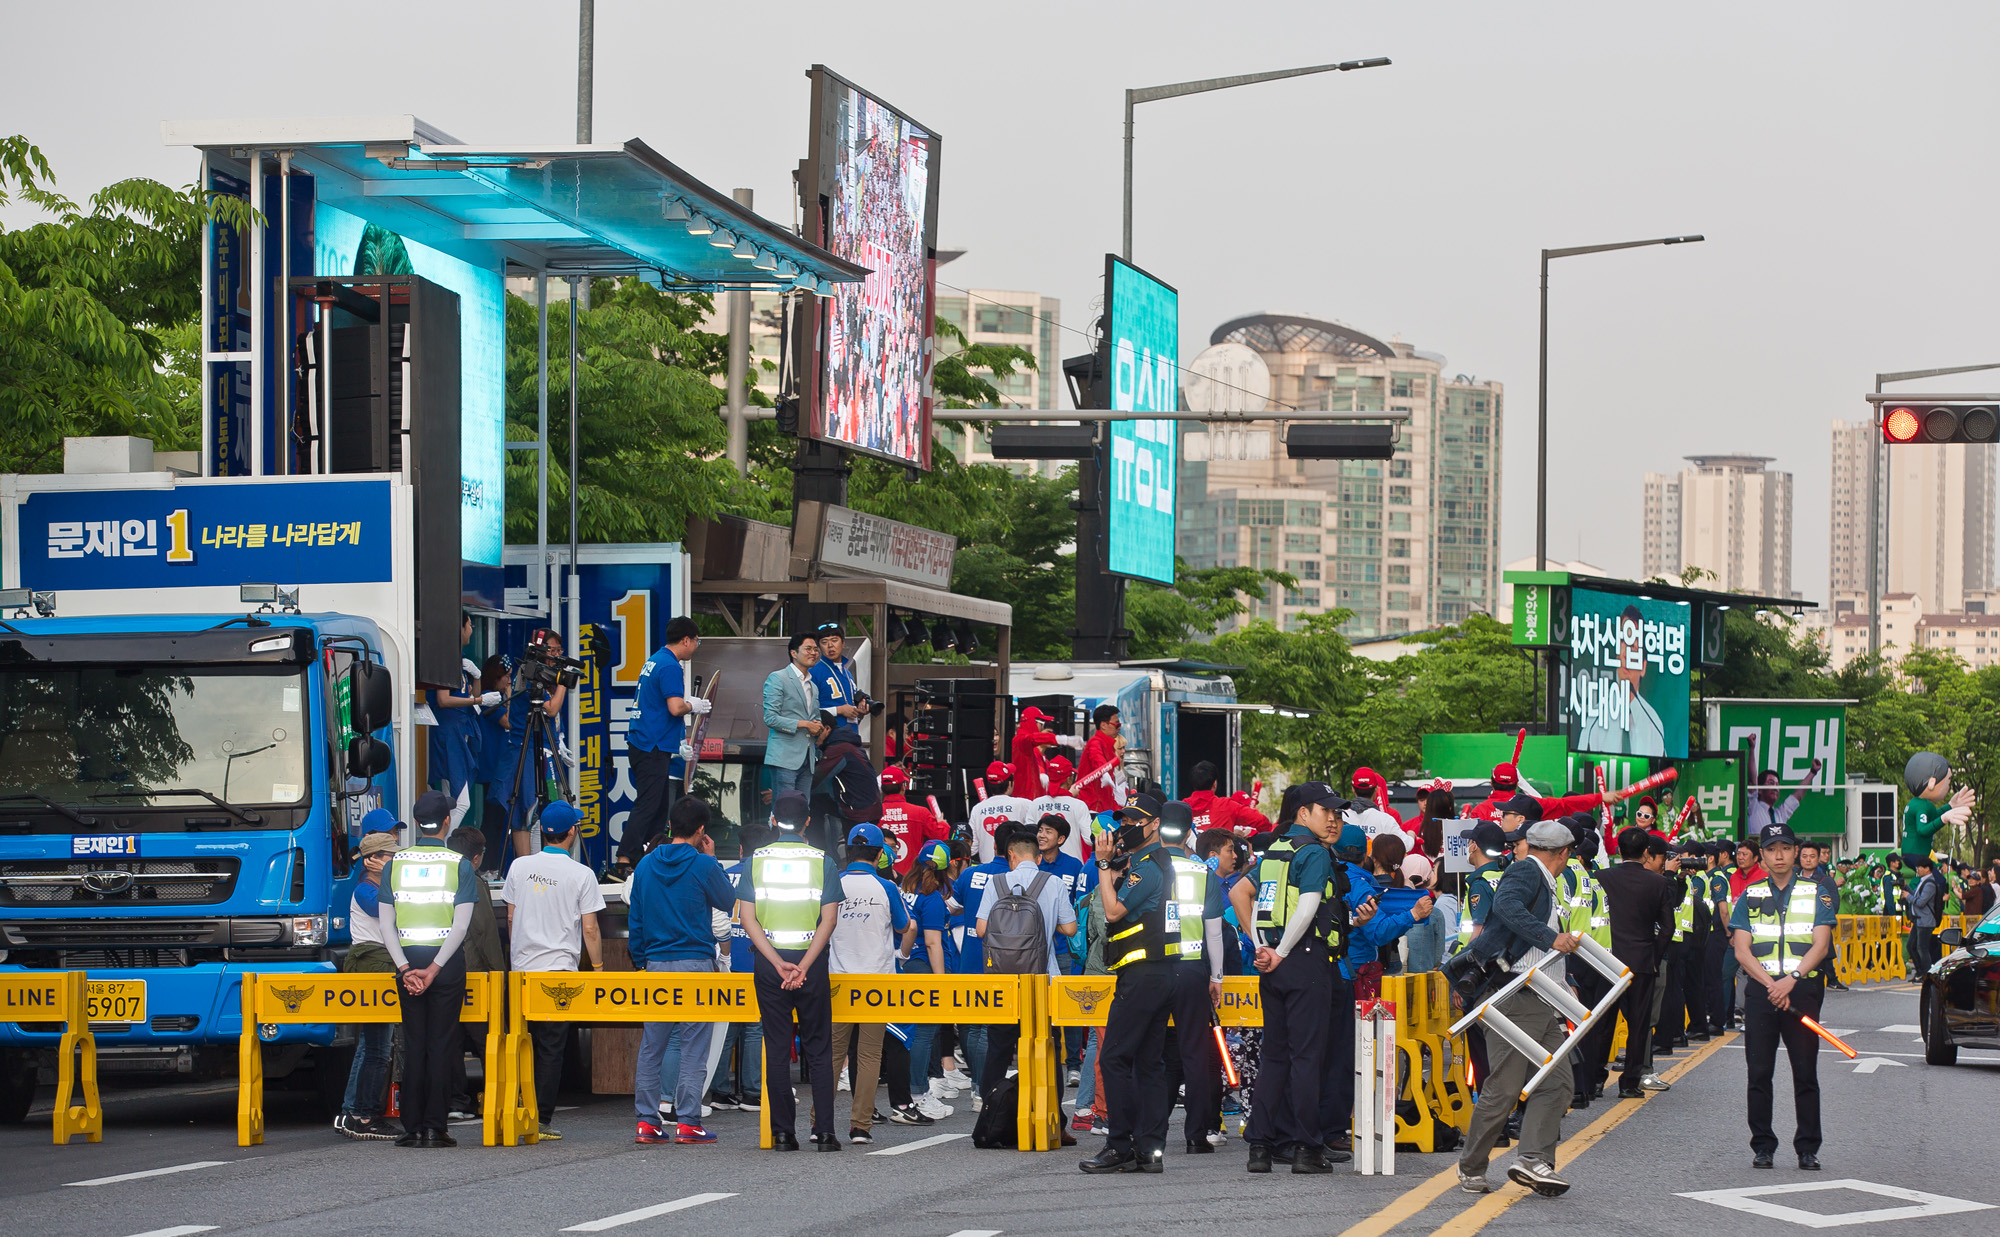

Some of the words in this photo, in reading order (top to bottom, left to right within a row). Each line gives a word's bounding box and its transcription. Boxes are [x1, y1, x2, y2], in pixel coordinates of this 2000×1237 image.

[1113, 337, 1175, 514] 유승민
[48, 520, 157, 558] 문재인
[166, 509, 194, 563] 1
[202, 524, 268, 549] 나라를
[272, 521, 361, 548] 나라답게
[1525, 602, 1538, 642] 안철수
[1554, 588, 1567, 642] 3
[611, 589, 651, 687] 1
[1707, 608, 1720, 659] 3
[826, 677, 842, 699] 1
[1570, 675, 1630, 732] 시대에
[1727, 718, 1840, 796] 미래
[579, 735, 602, 838] 대통령
[980, 805, 1013, 816] 사랑해요
[1038, 802, 1071, 812] 사랑해요
[1697, 785, 1734, 841] 변
[1920, 813, 1928, 824] 3
[1357, 825, 1377, 834] 해요
[73, 837, 124, 854] 문재인
[126, 836, 136, 854] 1
[842, 912, 871, 923] 0509
[7, 988, 55, 1006] LINE
[108, 984, 125, 994] 87
[324, 988, 397, 1007] POLIC
[595, 988, 683, 1006] POLICE
[697, 989, 746, 1006] LINE
[851, 989, 940, 1007] POLICE
[953, 990, 1004, 1008] LINE
[1223, 992, 1259, 1009] 마시
